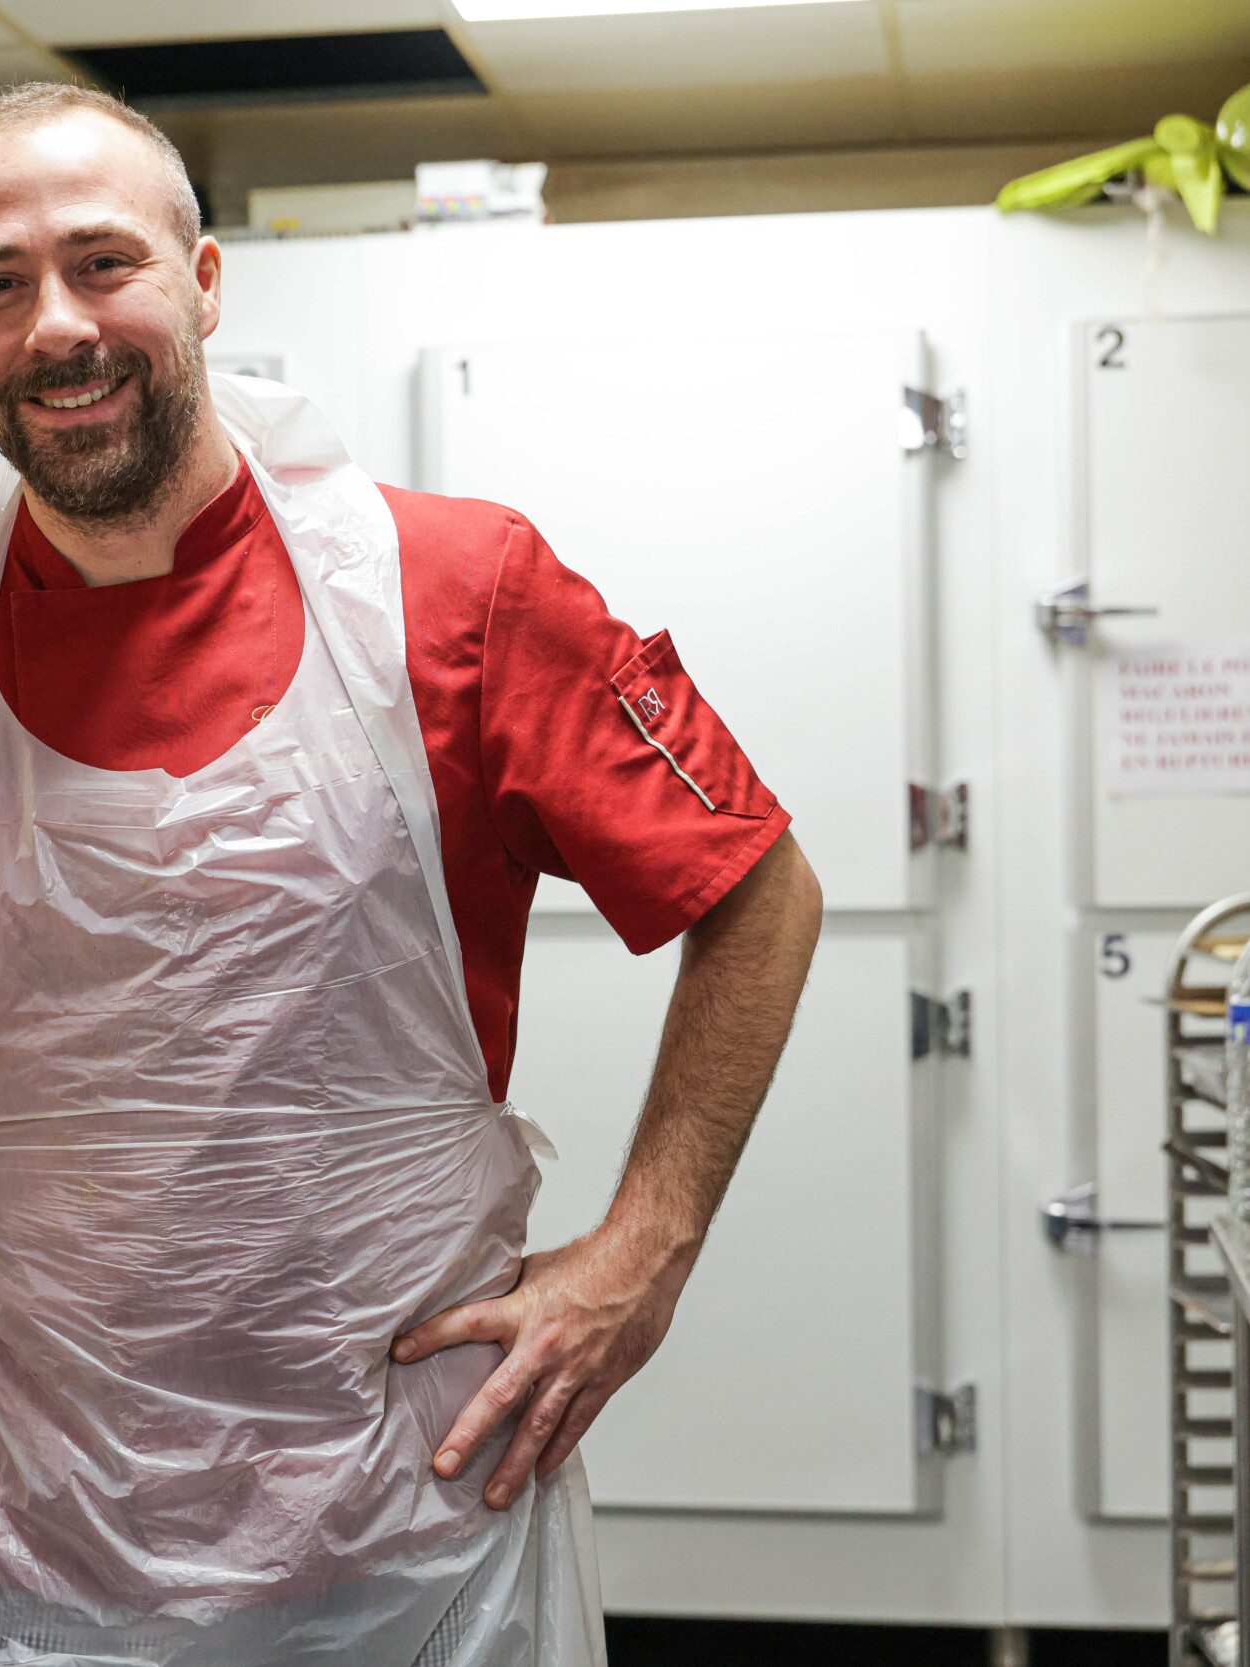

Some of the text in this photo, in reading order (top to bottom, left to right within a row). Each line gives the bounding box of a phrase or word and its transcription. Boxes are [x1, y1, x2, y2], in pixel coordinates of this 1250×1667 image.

[1097, 326, 1125, 369] 2
[454, 357, 469, 395] 1
[1103, 933, 1132, 980] 5
